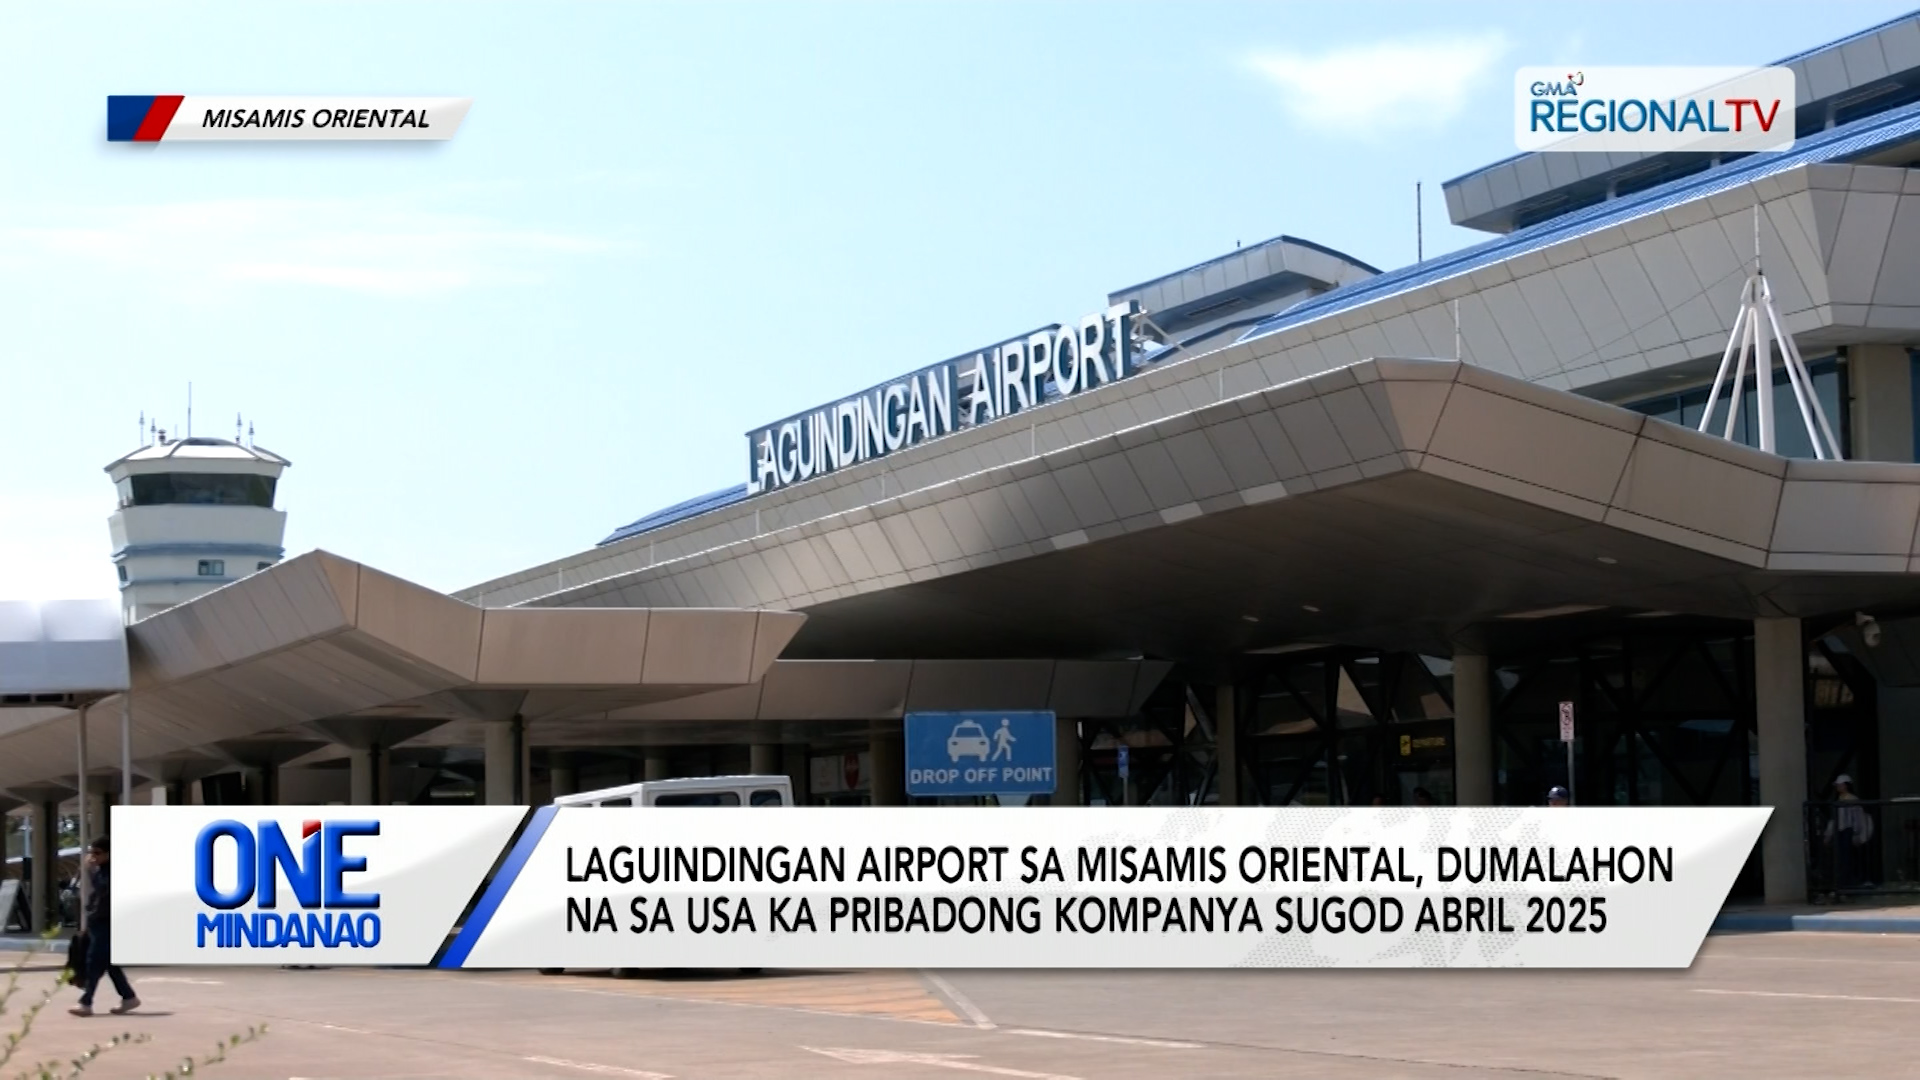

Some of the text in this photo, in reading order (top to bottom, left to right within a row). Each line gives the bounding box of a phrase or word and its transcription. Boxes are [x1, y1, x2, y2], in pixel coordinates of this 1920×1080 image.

[747, 301, 1138, 496] LAGUINDINGAN AIRPORT
[910, 767, 1052, 784] DROP OFF POINT
